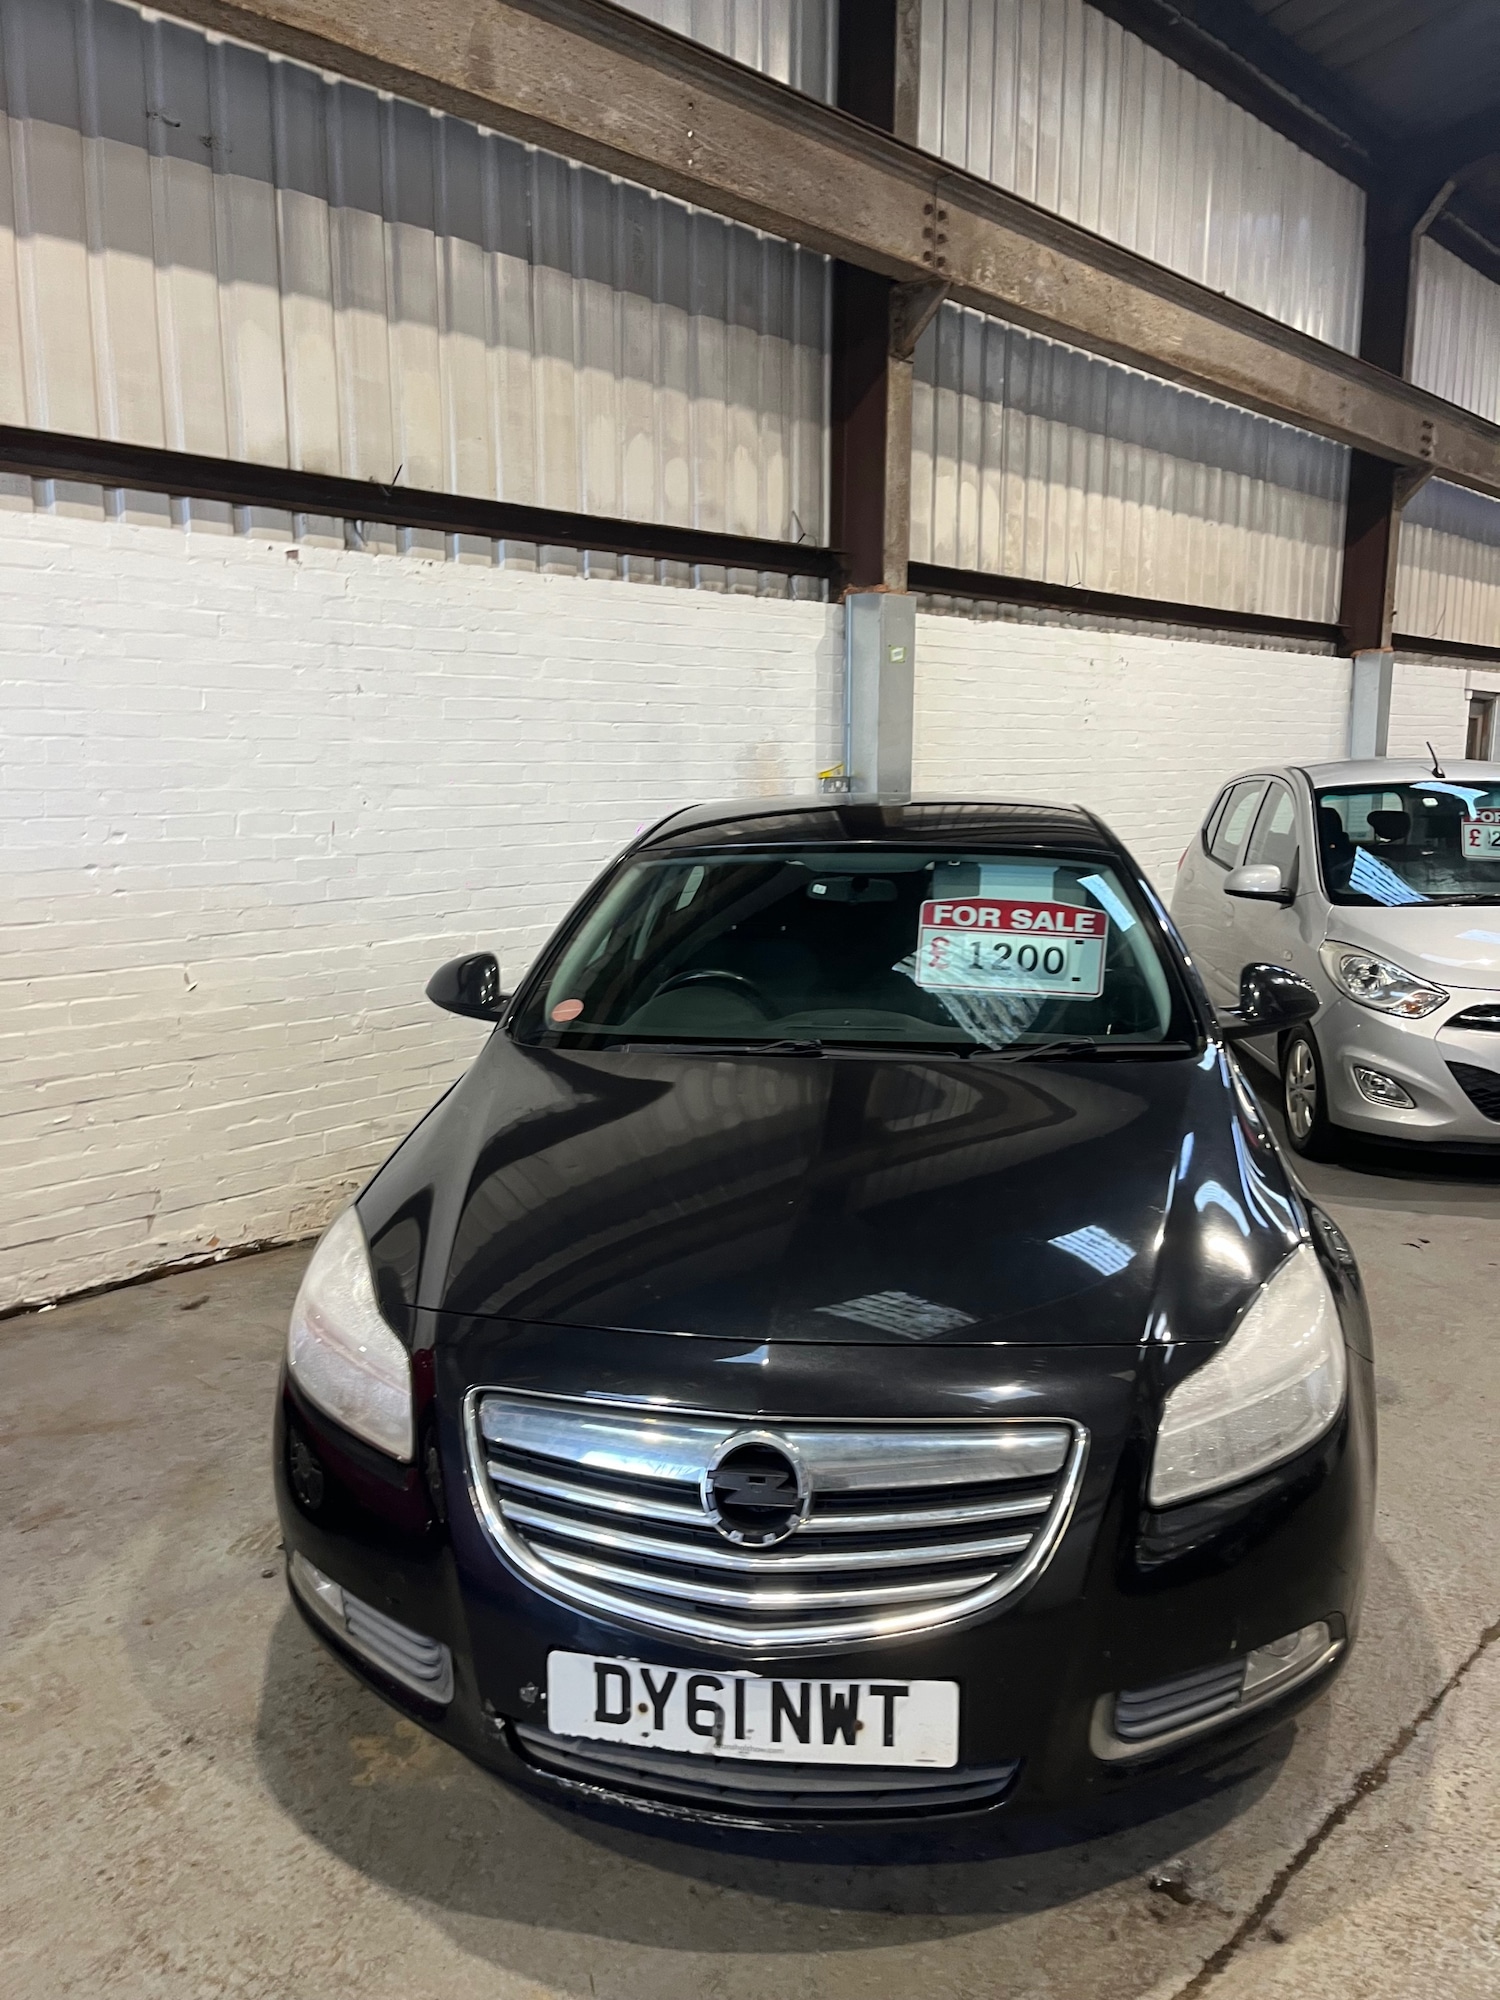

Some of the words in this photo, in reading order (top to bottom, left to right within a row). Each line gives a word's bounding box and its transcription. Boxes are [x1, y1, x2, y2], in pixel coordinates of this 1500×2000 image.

[1468, 828, 1481, 847] £
[933, 905, 1001, 927] FOR
[1010, 909, 1096, 933] SALE
[969, 941, 1064, 975] 1200
[594, 1662, 745, 1740] DY61
[771, 1681, 909, 1747] NWT
